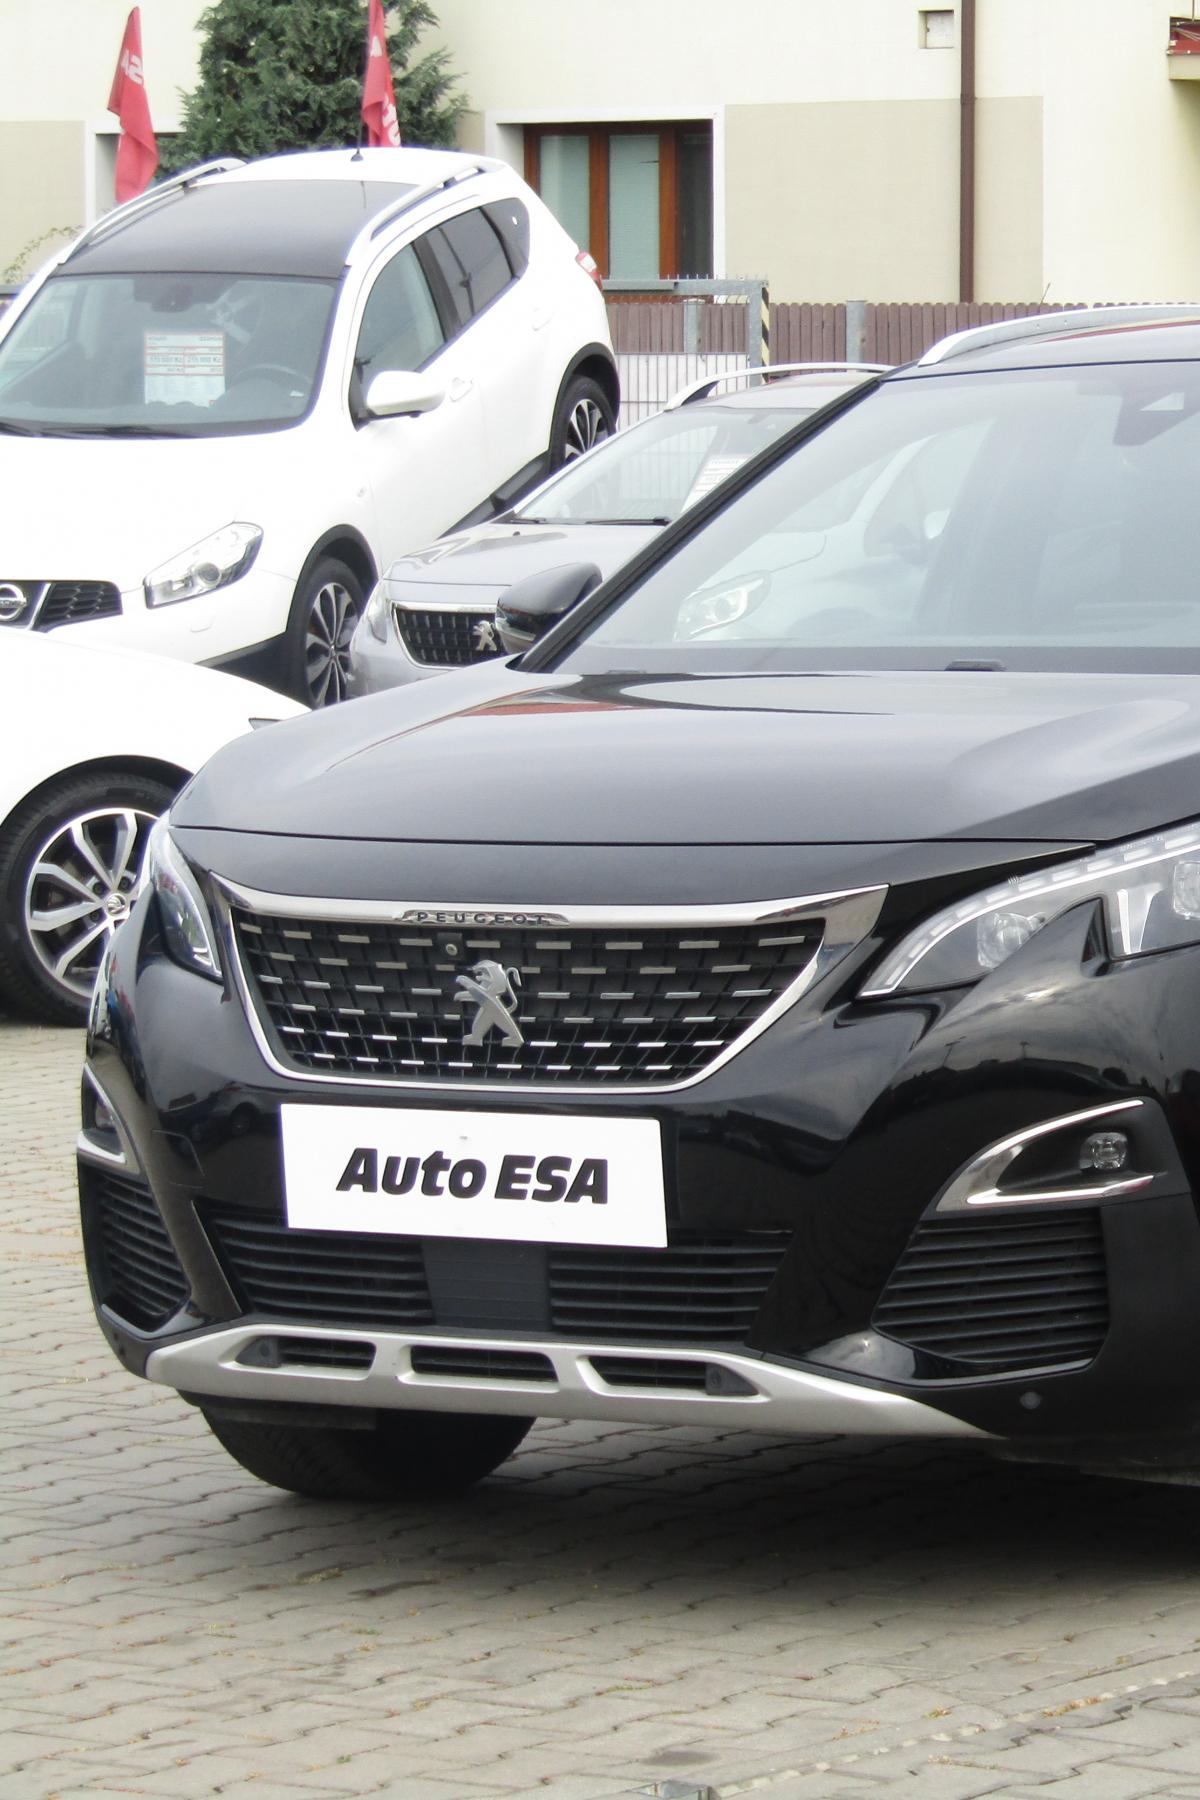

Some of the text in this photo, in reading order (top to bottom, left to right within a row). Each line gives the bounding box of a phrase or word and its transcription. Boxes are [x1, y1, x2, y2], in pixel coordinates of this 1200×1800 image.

[417, 911, 545, 925] PEUGEOT
[335, 1147, 608, 1205] Auto ESA
